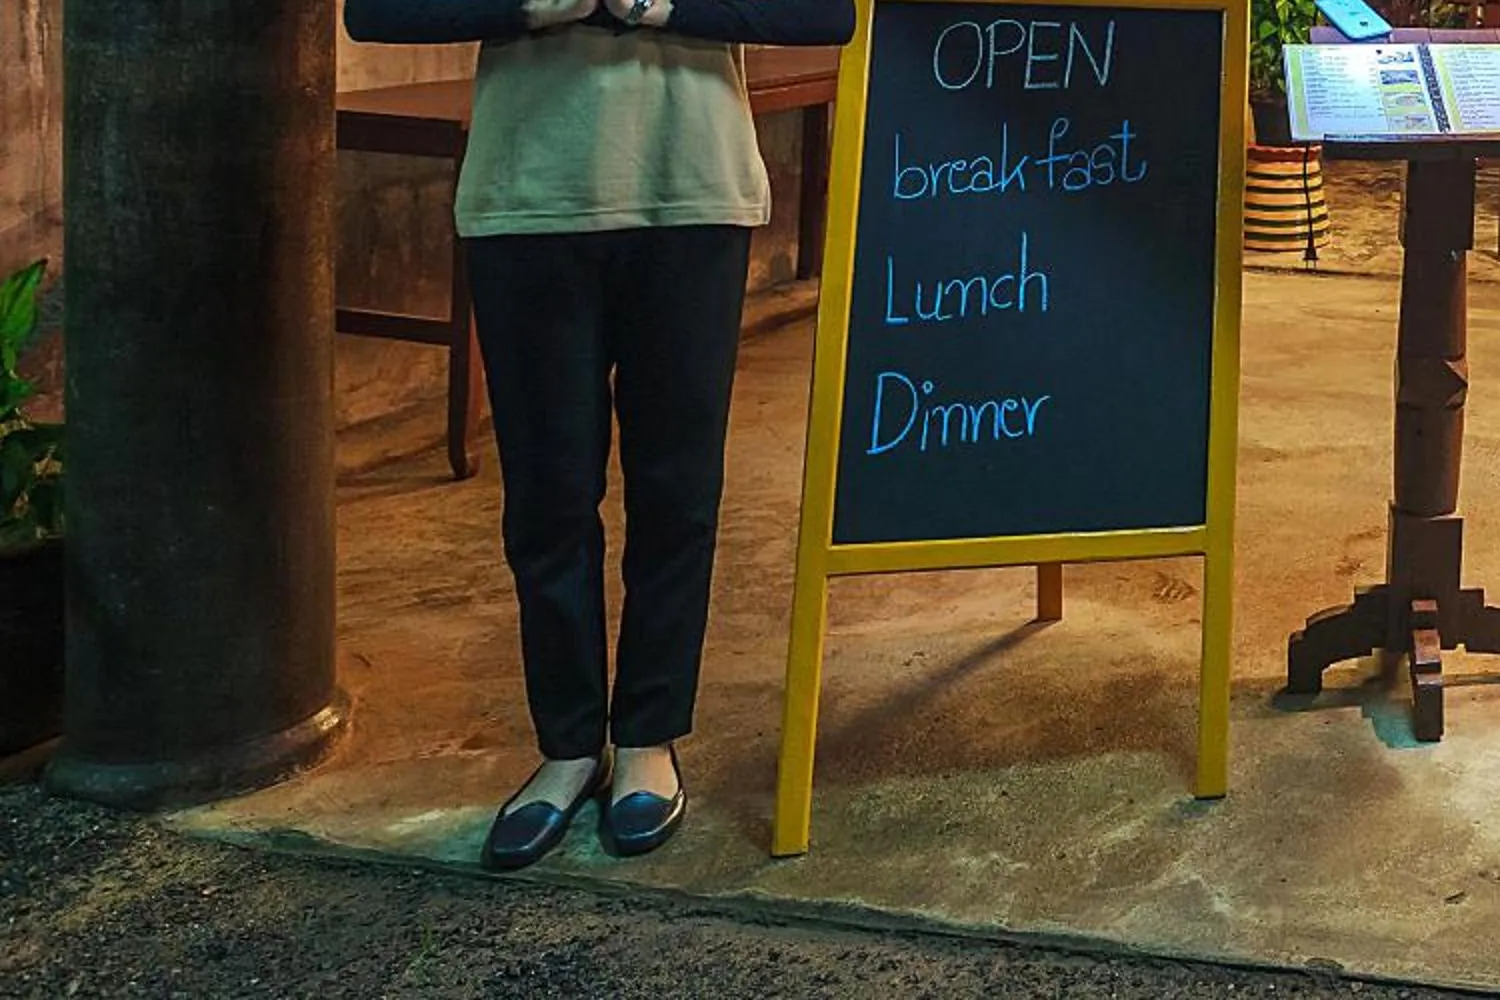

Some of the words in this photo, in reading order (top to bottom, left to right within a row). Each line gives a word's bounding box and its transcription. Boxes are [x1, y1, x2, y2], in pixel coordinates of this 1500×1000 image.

[933, 19, 1116, 90] OPEN
[884, 232, 1050, 324] Lunch
[866, 372, 1051, 456] Dinner
